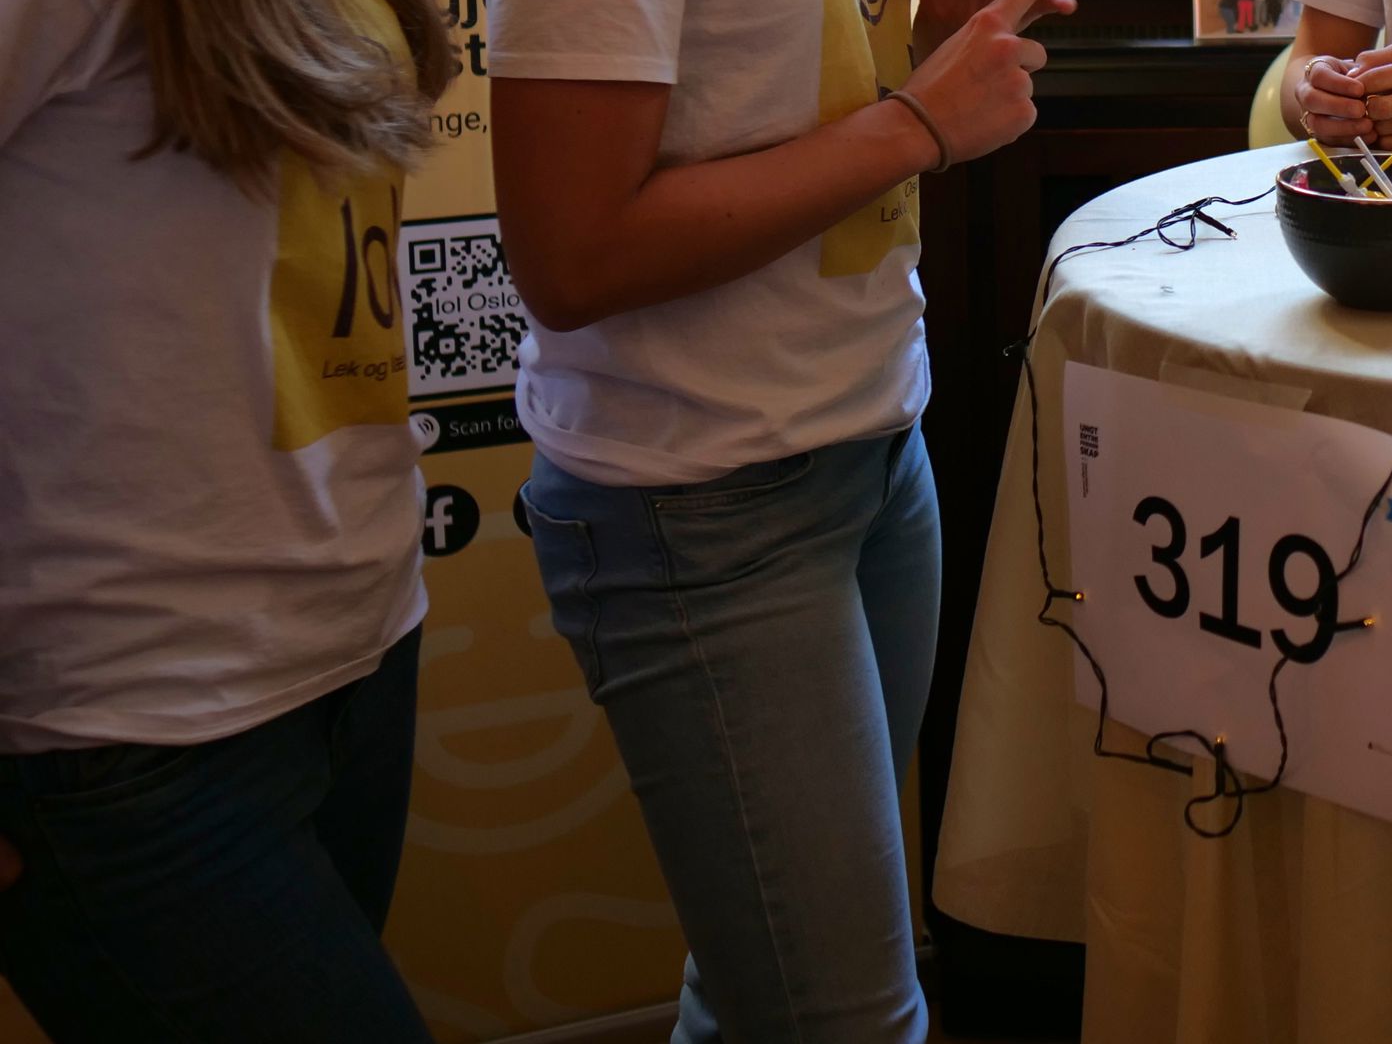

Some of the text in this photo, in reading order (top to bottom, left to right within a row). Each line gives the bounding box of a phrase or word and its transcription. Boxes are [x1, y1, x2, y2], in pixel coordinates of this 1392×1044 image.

[435, 291, 521, 315] lol Oslo
[322, 358, 360, 379] Lek
[363, 362, 389, 381] og
[449, 419, 491, 438] Scan
[1132, 495, 1340, 664] 319
